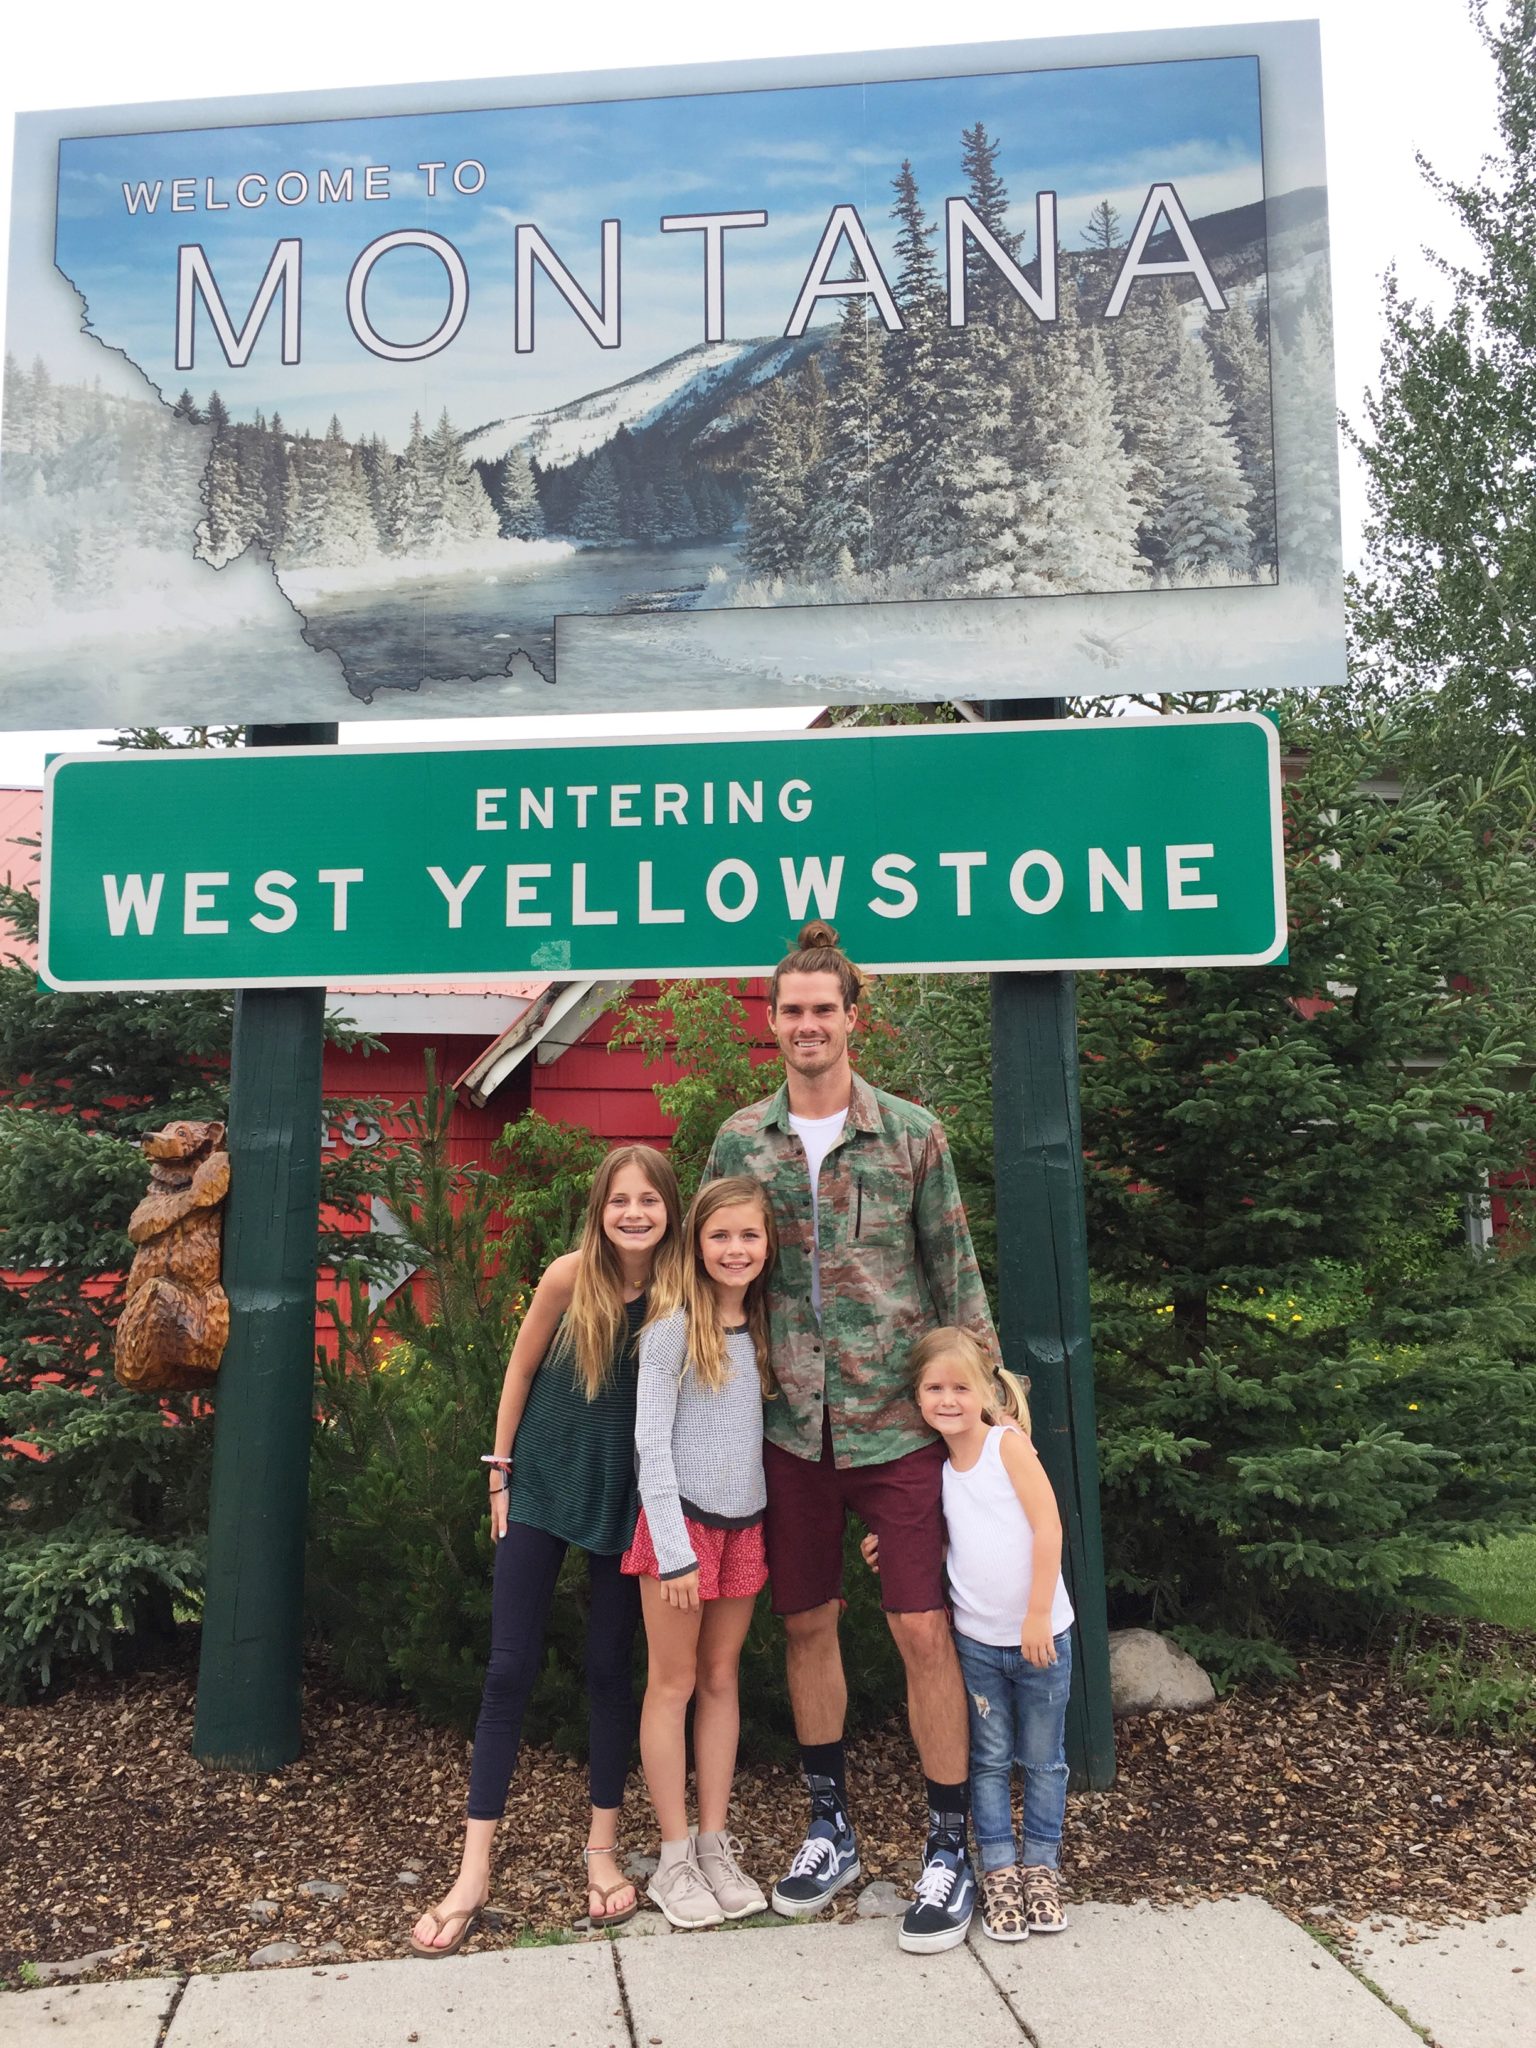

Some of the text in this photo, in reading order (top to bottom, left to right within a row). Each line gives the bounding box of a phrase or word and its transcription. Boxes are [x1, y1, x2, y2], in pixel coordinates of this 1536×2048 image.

[122, 159, 487, 216] WELCOME TO
[174, 182, 1228, 371] MONTANA
[475, 779, 814, 831] ENTERING
[102, 843, 1219, 937] WEST YELLOWSTONE
